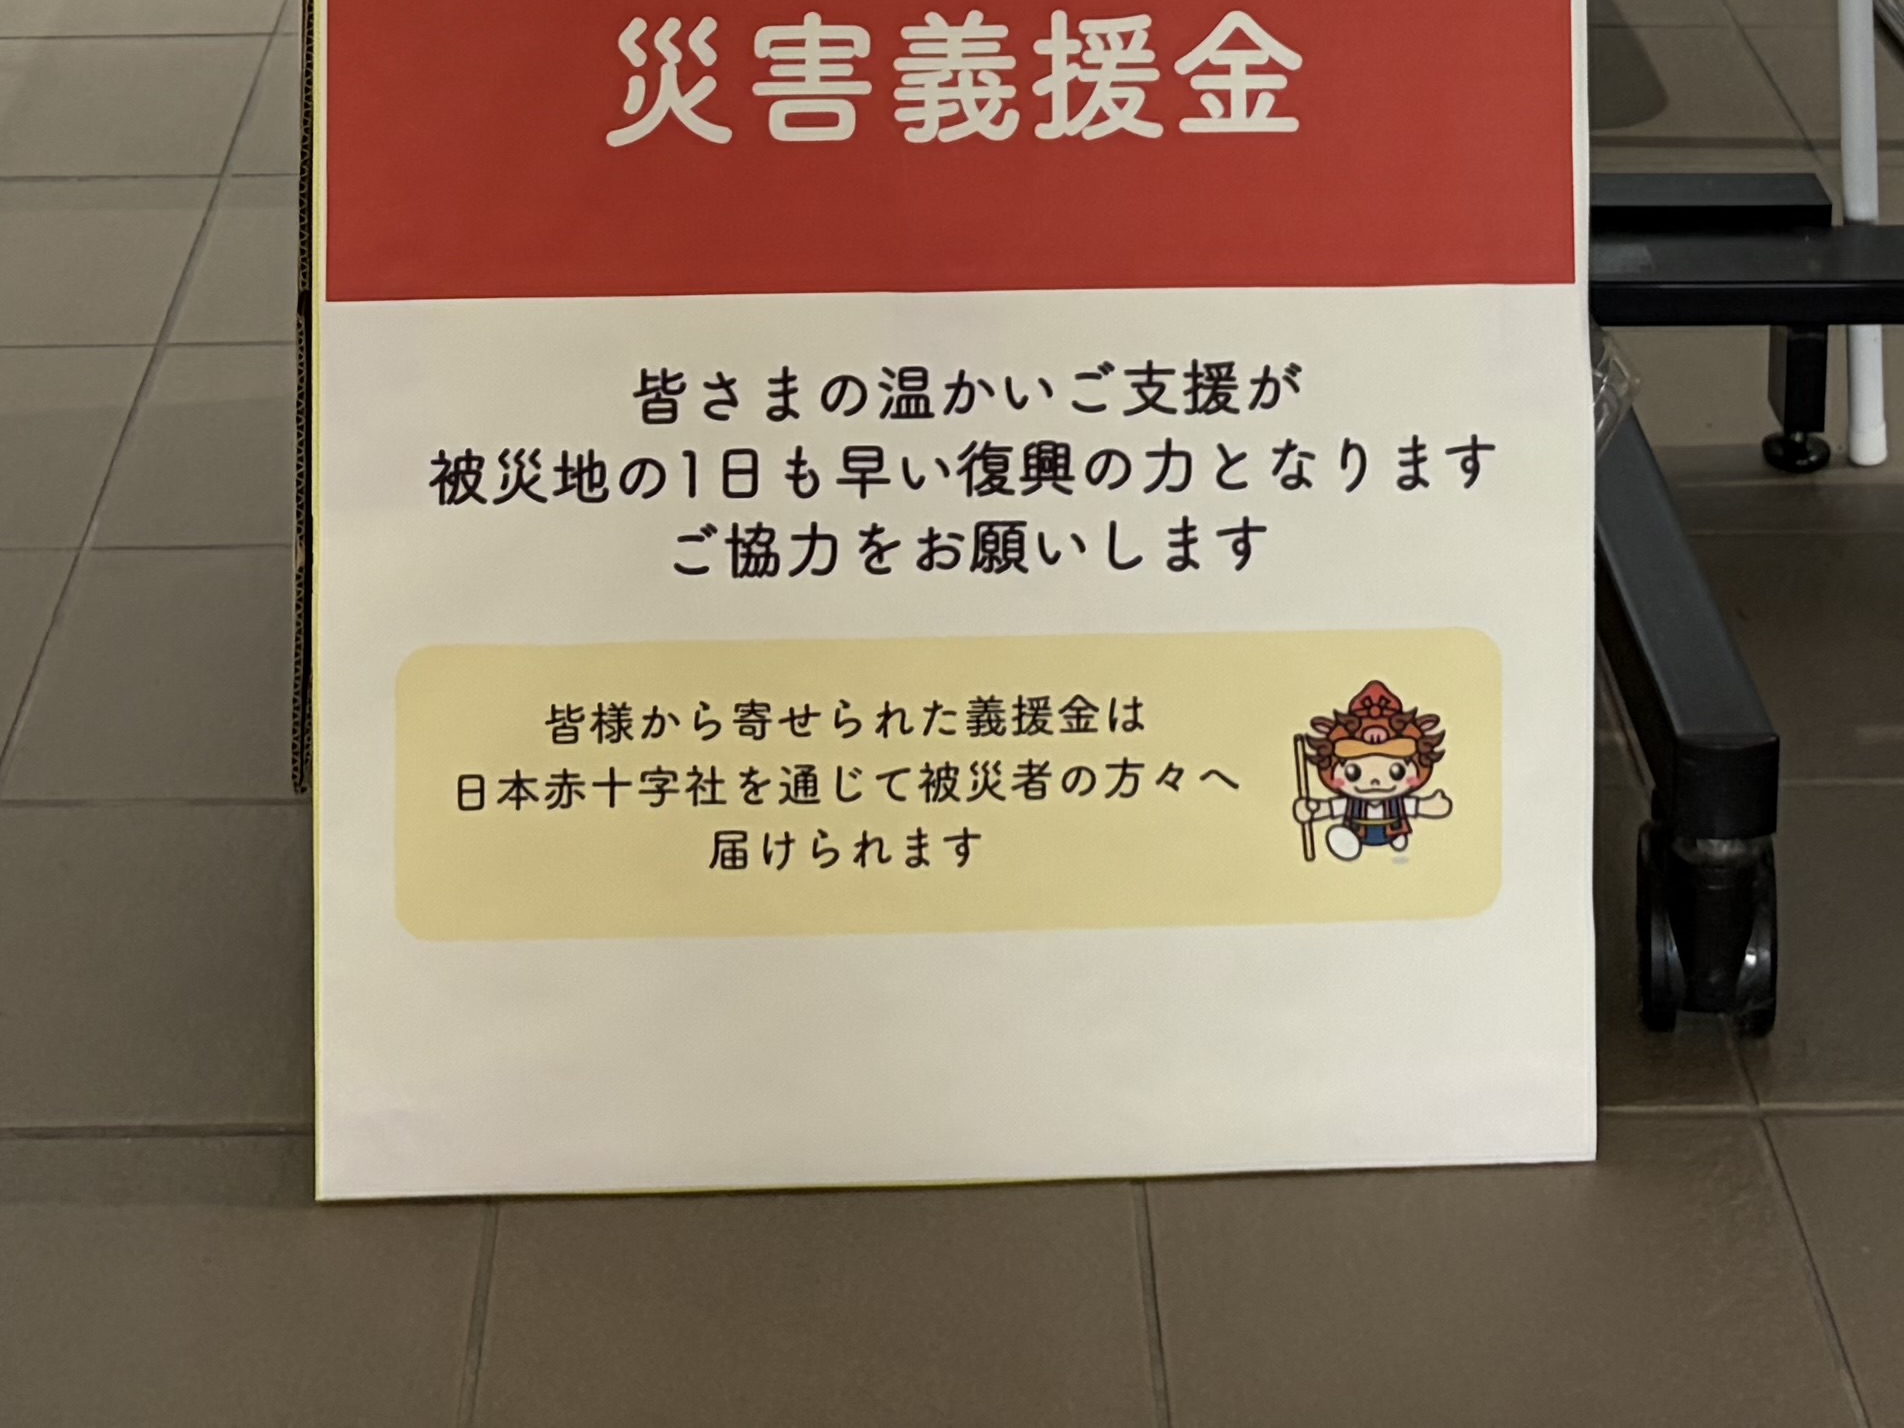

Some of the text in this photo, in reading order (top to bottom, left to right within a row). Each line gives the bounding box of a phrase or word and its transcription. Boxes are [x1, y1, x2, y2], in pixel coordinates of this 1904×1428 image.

[605, 8, 1304, 149] 災害義援金
[632, 358, 1302, 427] 皆さまの温かいご支援が
[429, 435, 1498, 508] 被災地の1日も早い復興の力となります
[670, 515, 1270, 582] ご協力をお願いします
[543, 692, 1149, 742] 皆様から寄せられた義援金は
[454, 758, 1243, 814] 日本赤十字社を通じて被災者の方々へ
[707, 827, 984, 874] 届けられます
